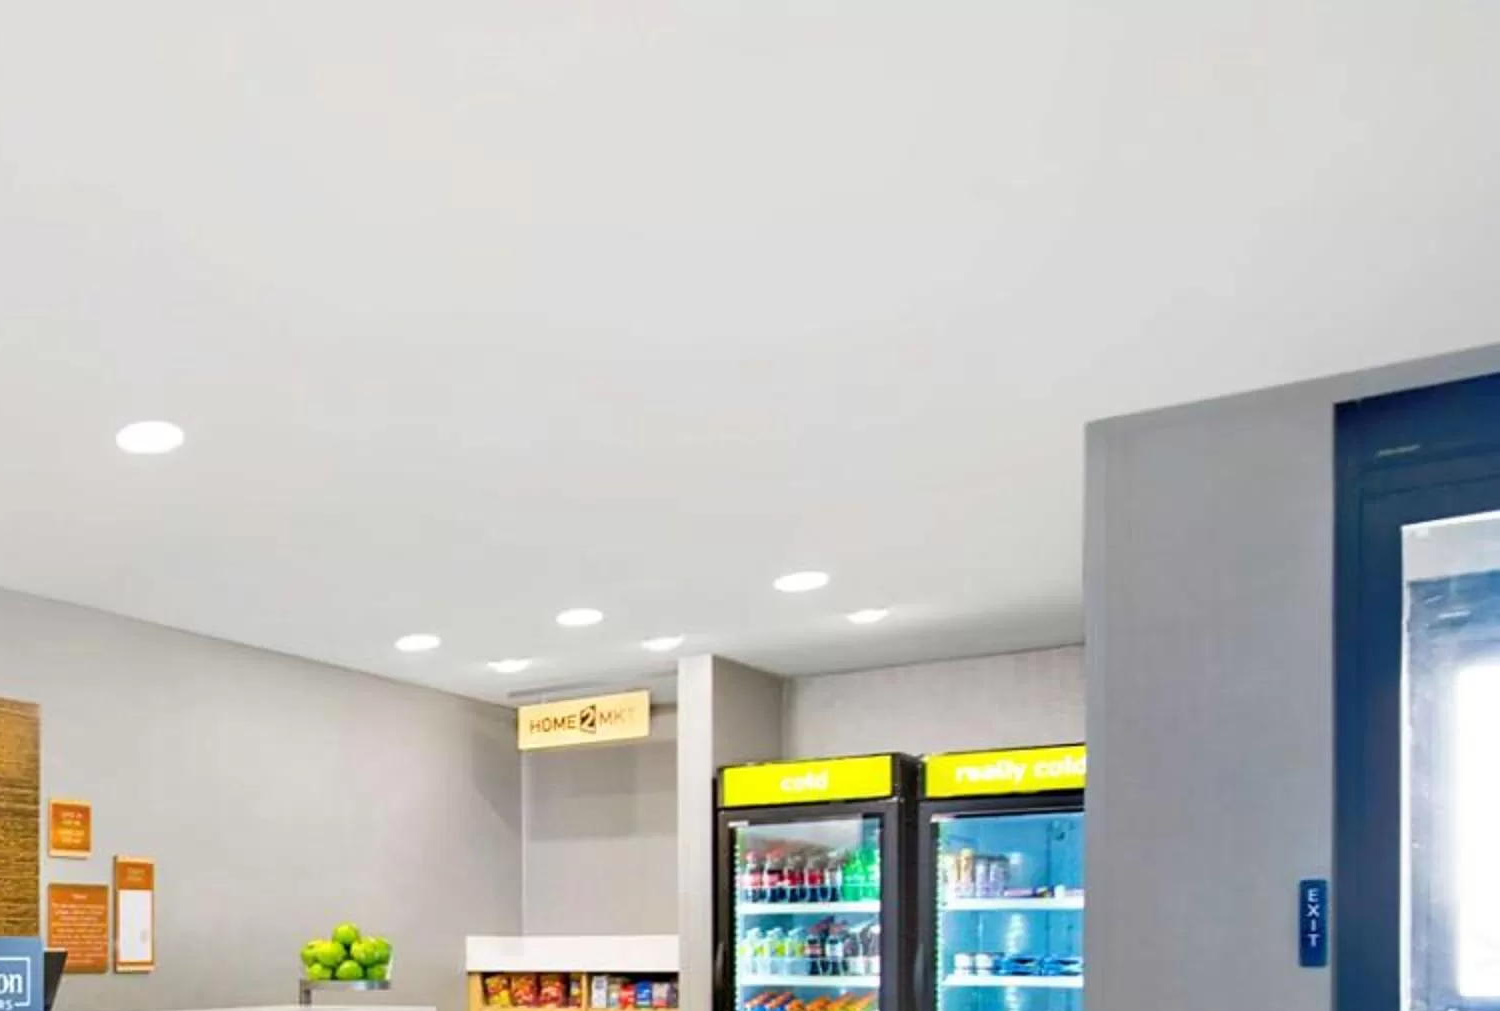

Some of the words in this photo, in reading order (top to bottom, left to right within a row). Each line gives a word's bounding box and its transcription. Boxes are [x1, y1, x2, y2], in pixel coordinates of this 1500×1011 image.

[779, 769, 829, 792] cold
[955, 759, 1027, 784] really
[1307, 887, 1320, 947] EXIT
